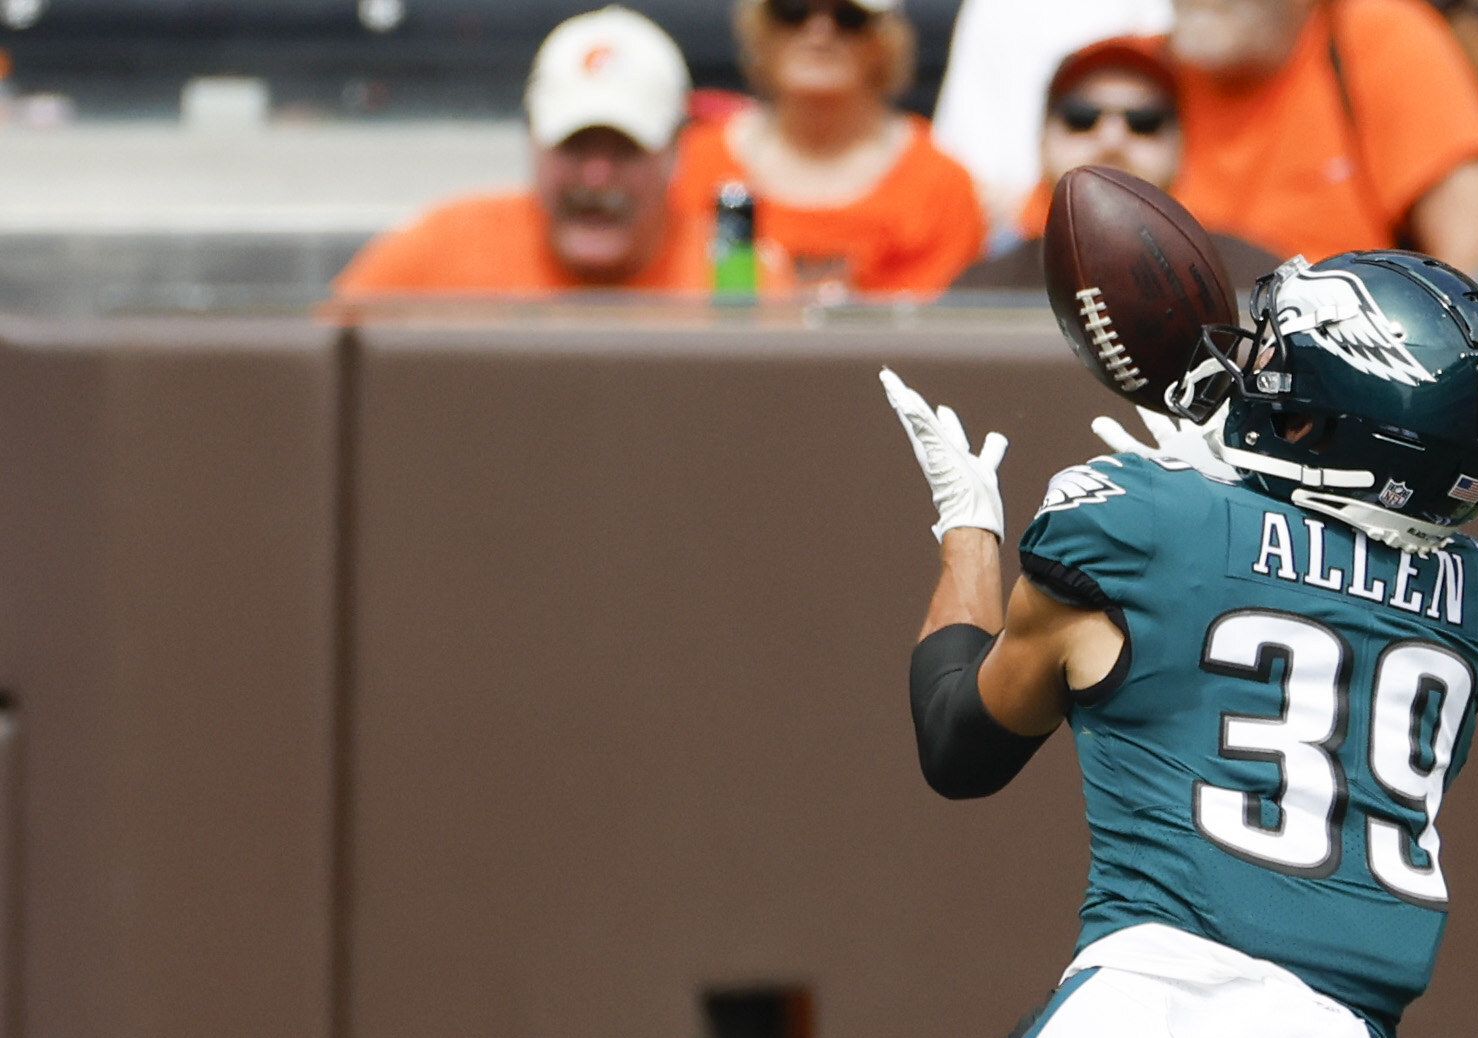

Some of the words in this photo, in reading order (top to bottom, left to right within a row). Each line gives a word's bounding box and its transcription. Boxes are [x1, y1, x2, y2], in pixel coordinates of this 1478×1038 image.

[1383, 489, 1406, 506] NFL
[1251, 509, 1465, 627] ALLEN
[1194, 608, 1475, 911] 39
